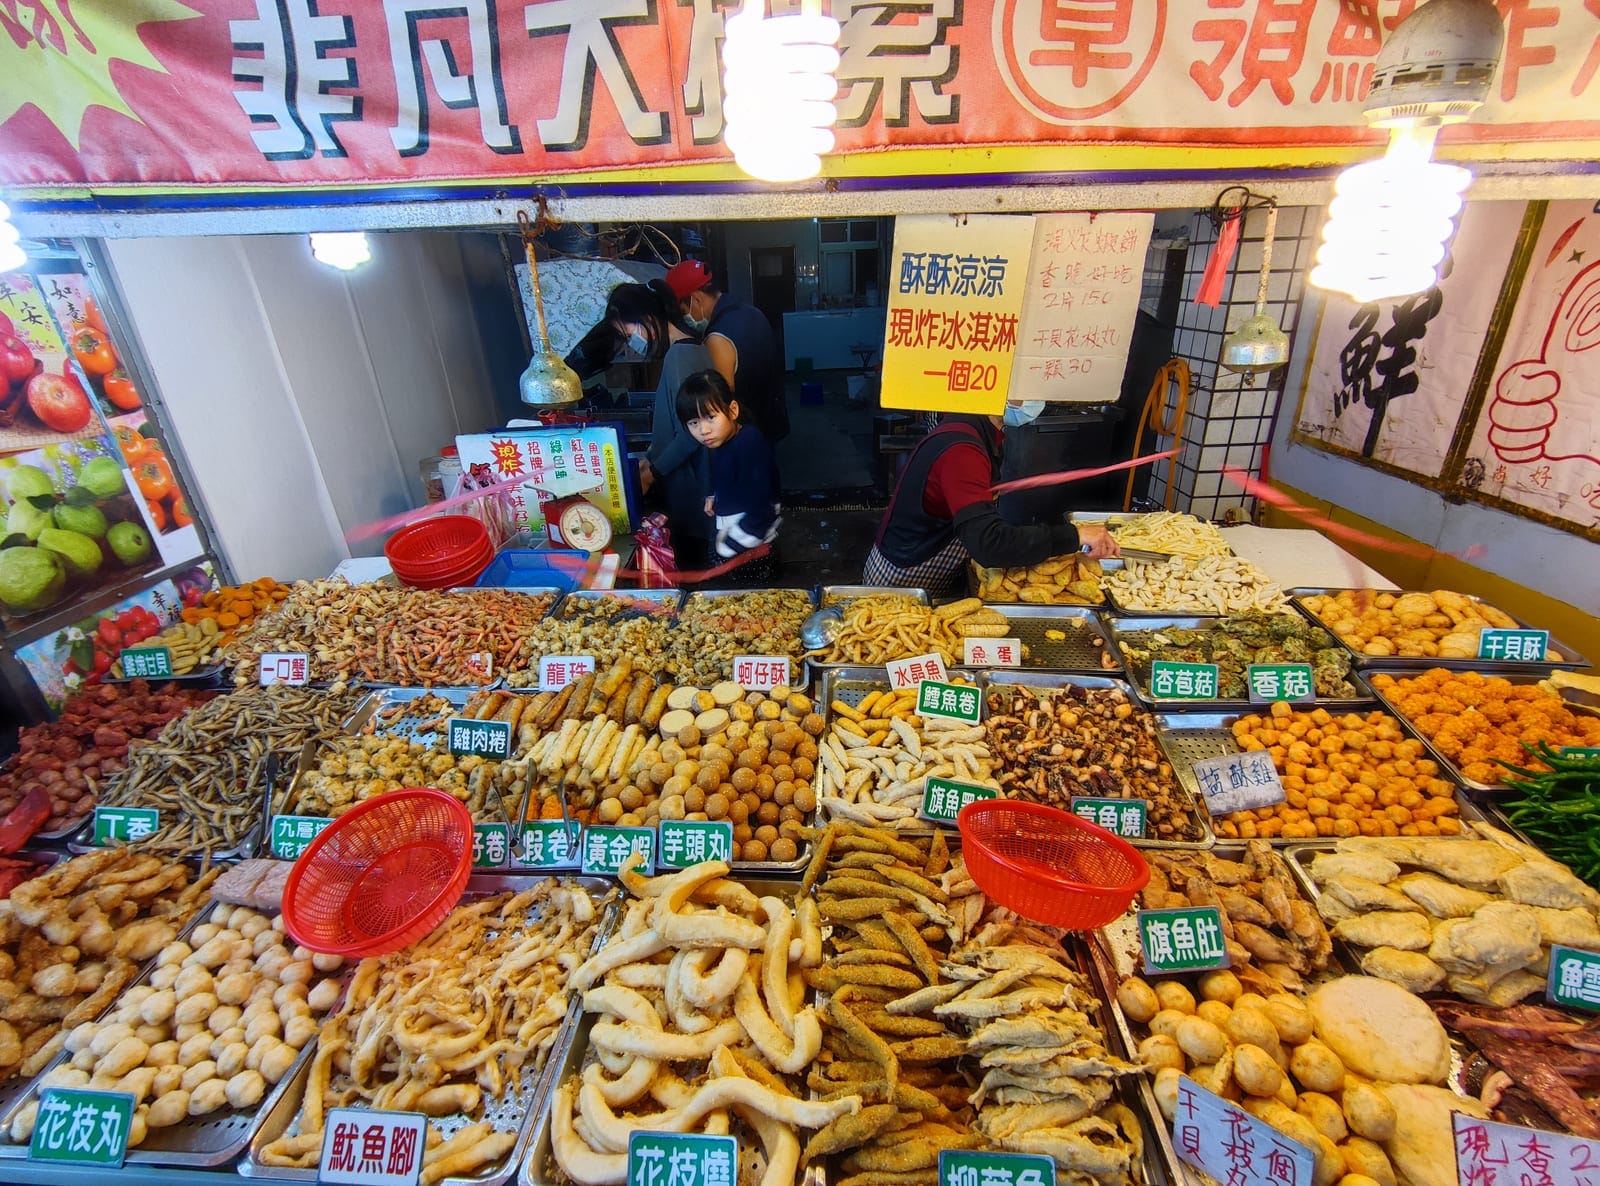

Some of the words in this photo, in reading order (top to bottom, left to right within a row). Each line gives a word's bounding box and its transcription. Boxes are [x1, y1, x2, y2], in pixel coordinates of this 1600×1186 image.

[900, 252, 1008, 297] 酥酥涼涼
[50, 279, 86, 324] 如意
[888, 308, 1018, 352] 現炸冰淇淋
[923, 360, 998, 392] 一個20
[262, 658, 305, 682] 一口蟹
[970, 645, 1014, 664] 魚蛋
[738, 662, 786, 685] 蚵仔酥
[894, 660, 943, 687] 水晶魚
[1253, 670, 1311, 698] 香菇
[453, 727, 507, 754] 雞肉捲
[99, 814, 153, 841] 丁香
[588, 833, 651, 869] 黃金蝦
[664, 828, 729, 863] 芋頭丸
[1146, 917, 1224, 964] 旗魚肚
[39, 1095, 122, 1156] 花枝丸
[328, 1122, 418, 1176] 魷魚腳
